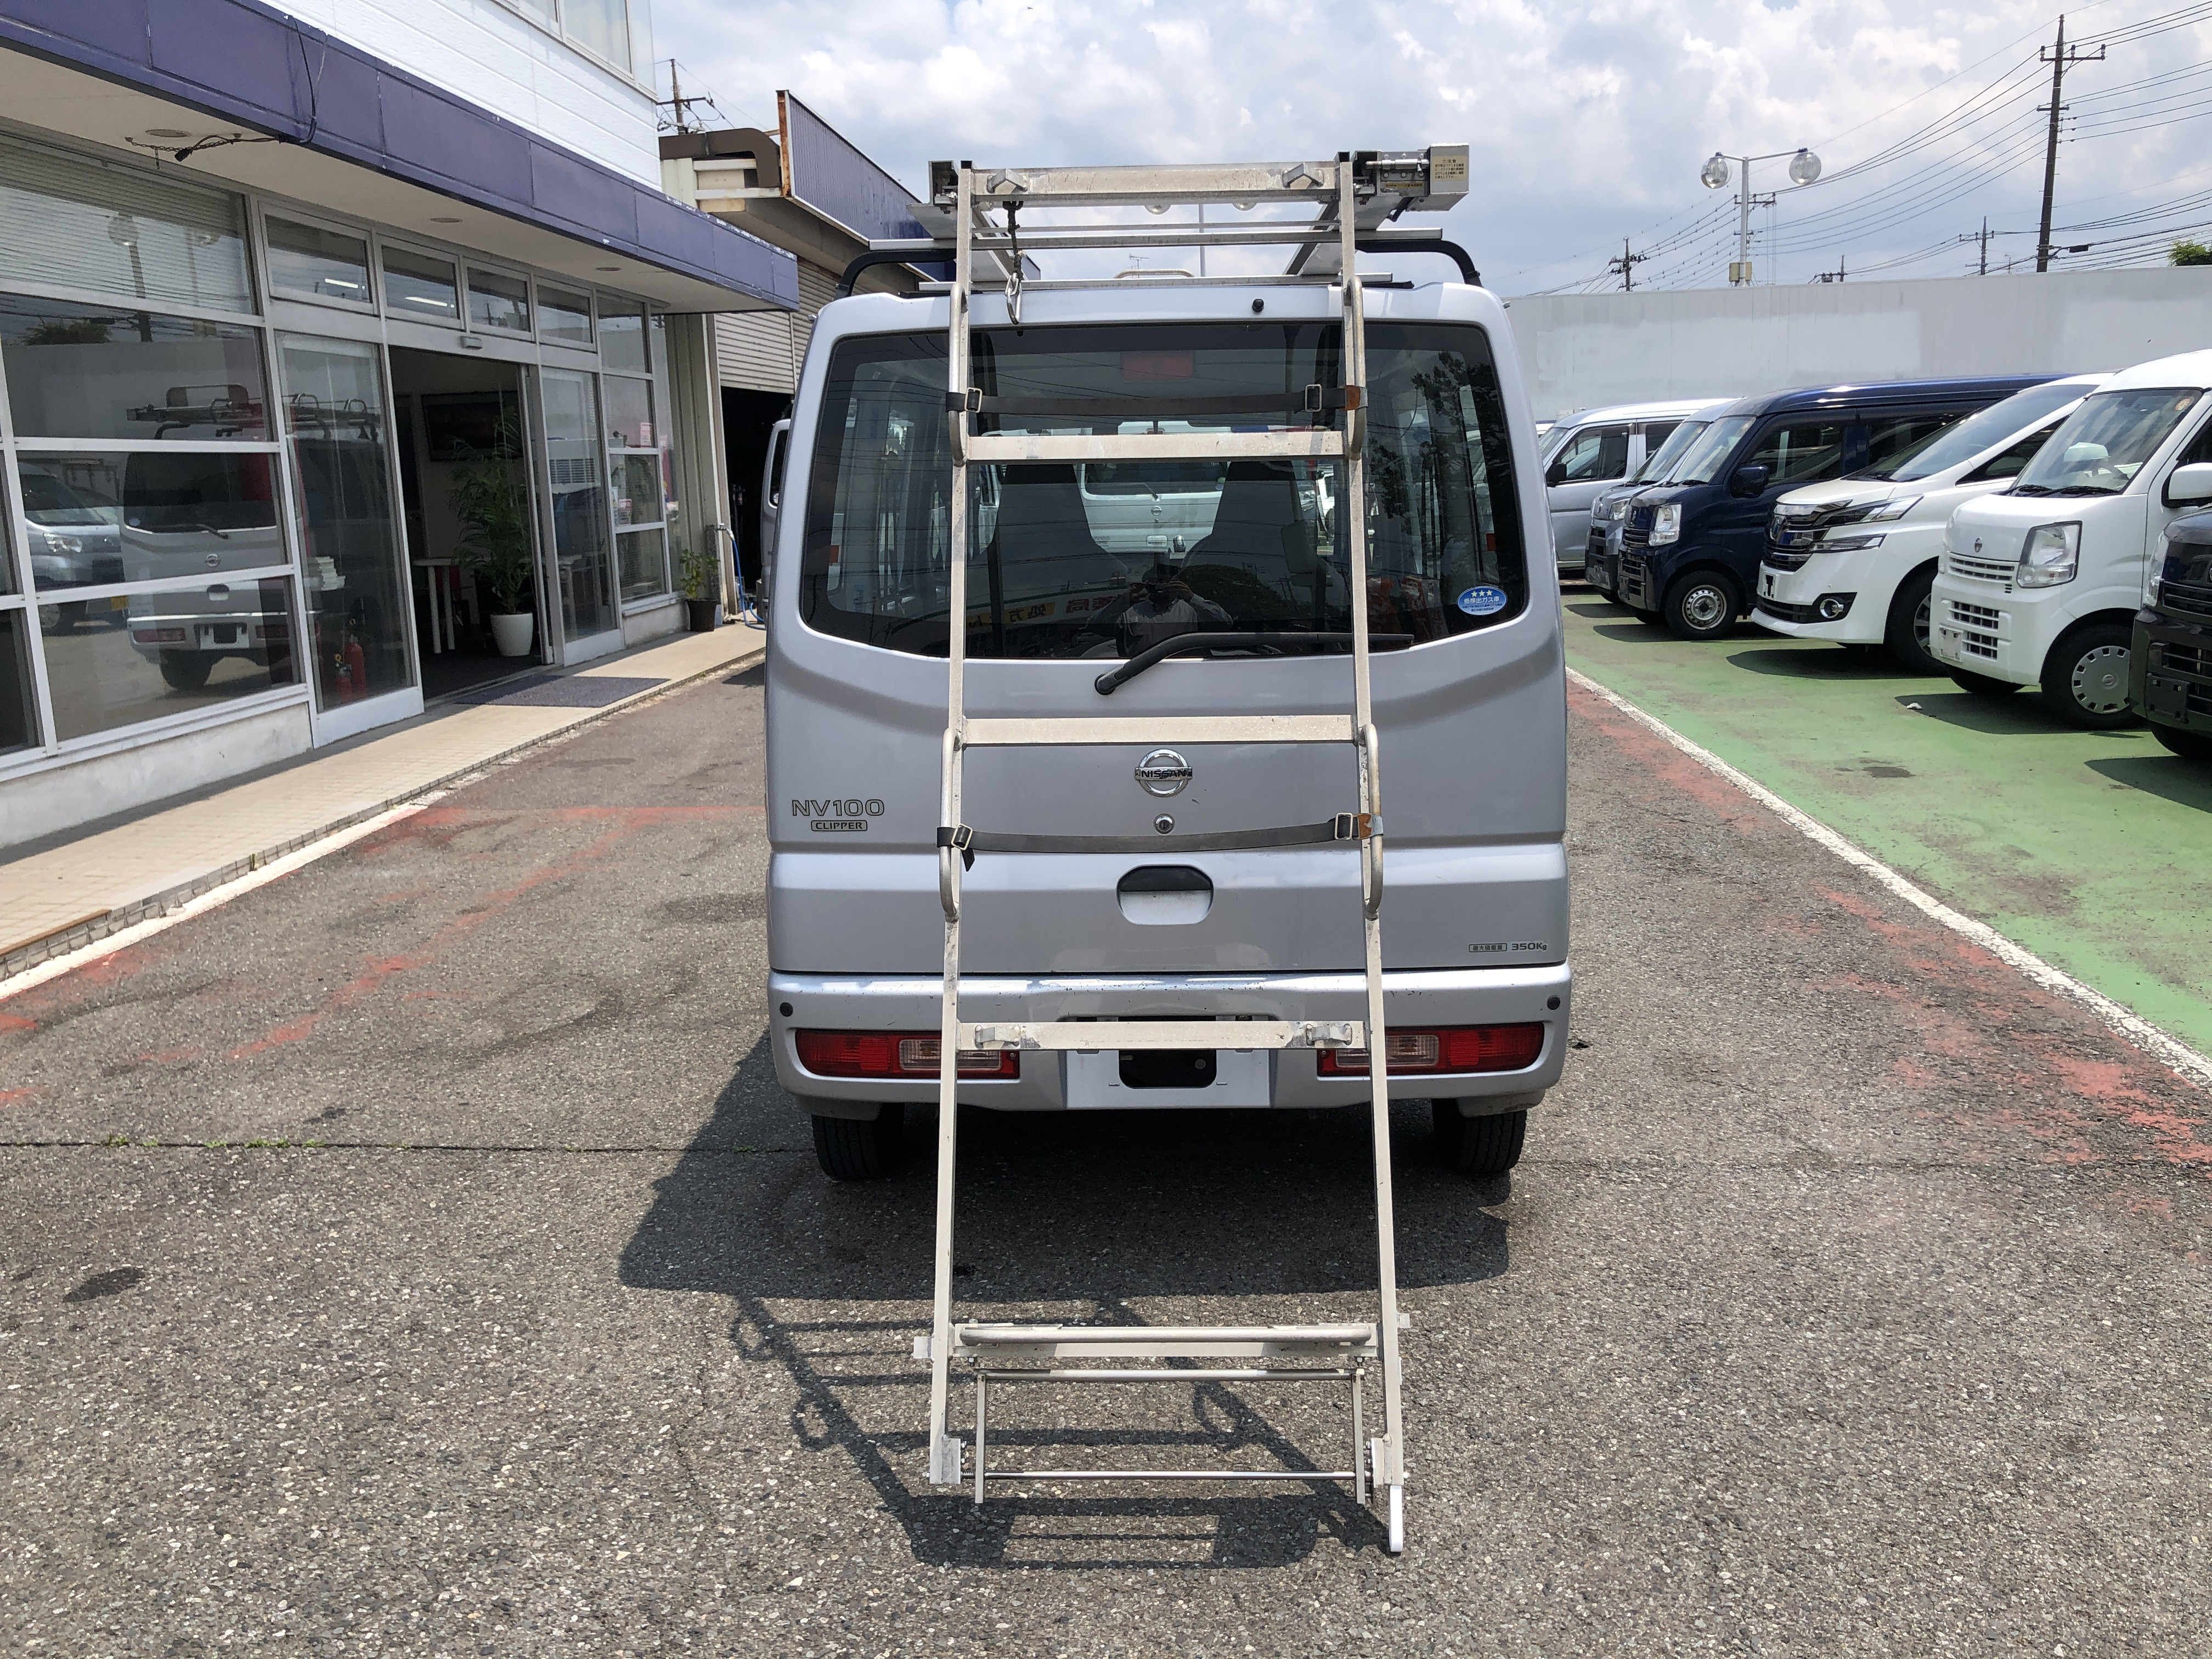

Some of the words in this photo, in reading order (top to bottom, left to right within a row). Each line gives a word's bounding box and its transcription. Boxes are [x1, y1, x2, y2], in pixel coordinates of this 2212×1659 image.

[1464, 596, 1500, 605] 低排出ガス車
[1141, 770, 1186, 778] NISSAN
[792, 799, 885, 816] NV100
